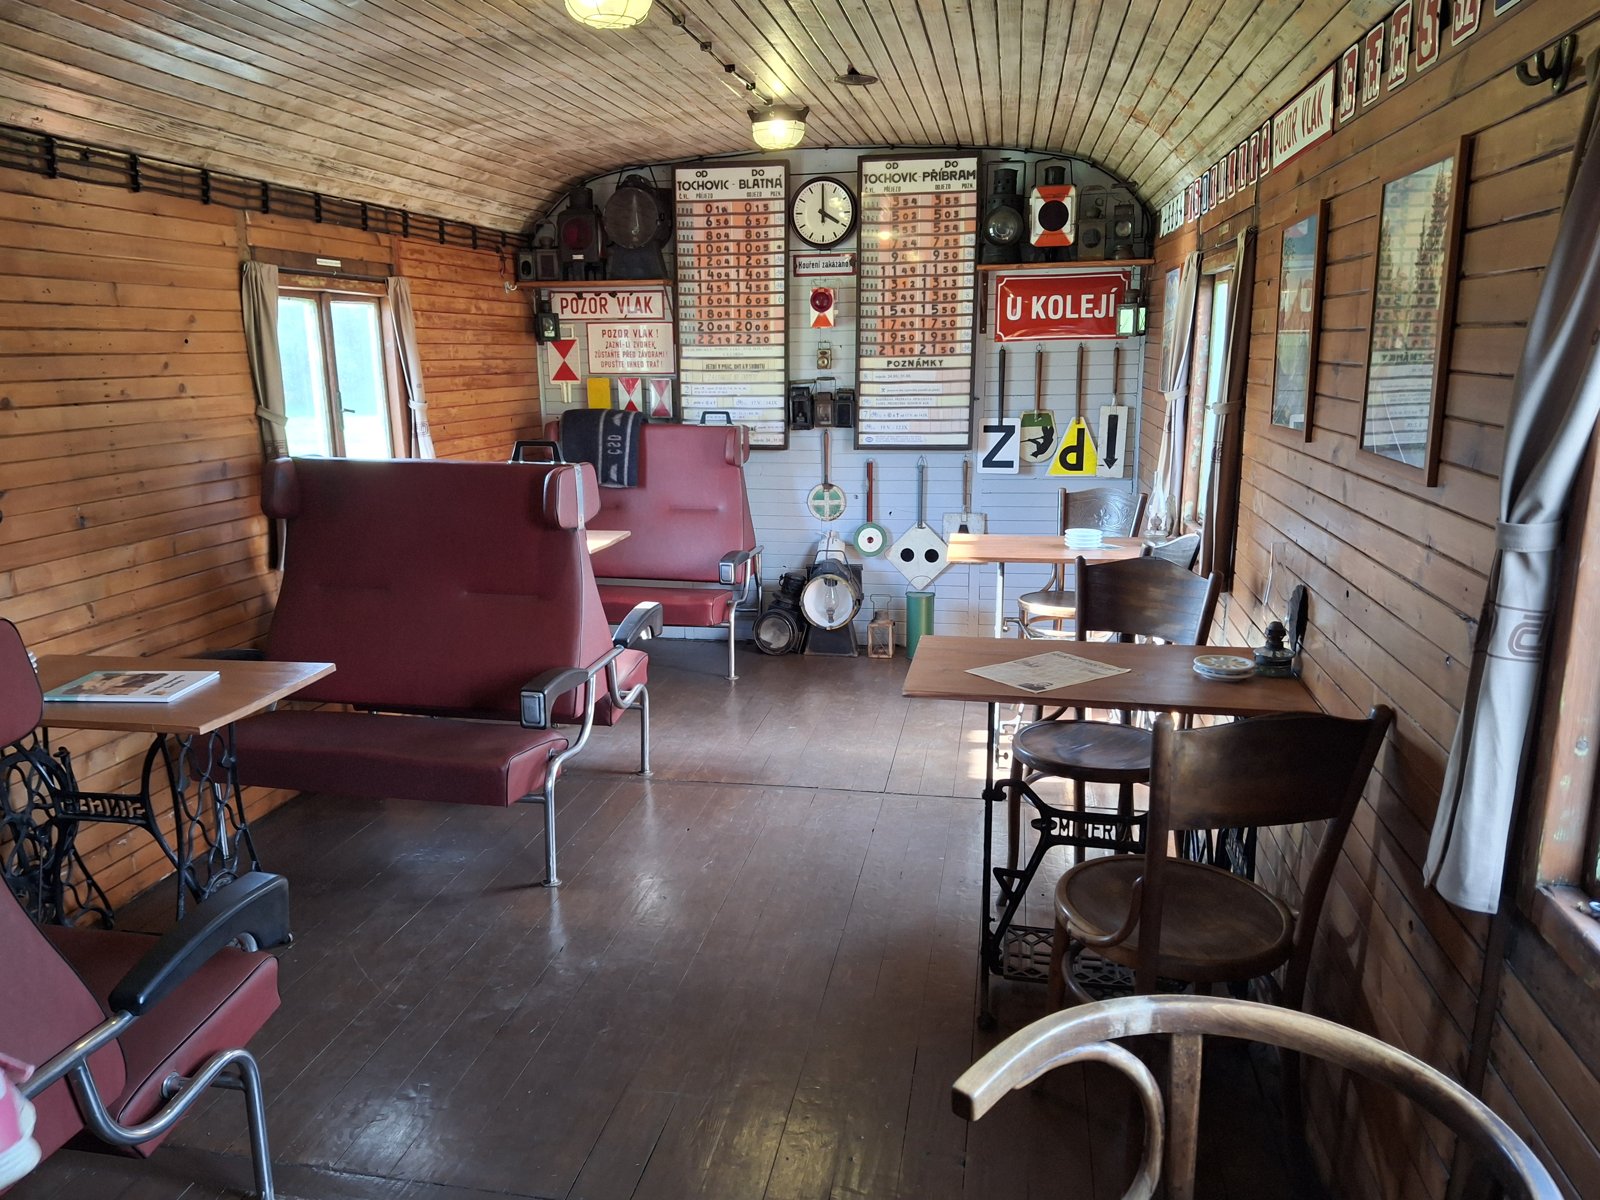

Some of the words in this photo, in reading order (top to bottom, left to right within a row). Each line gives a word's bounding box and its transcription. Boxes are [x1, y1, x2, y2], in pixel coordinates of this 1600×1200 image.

[1275, 106, 1298, 157] POZOR
[1302, 84, 1325, 137] VLAK
[885, 162, 899, 170] OD
[944, 160, 959, 168] DO
[695, 170, 709, 178] OD
[751, 168, 765, 177] DO
[677, 180, 730, 191] TOCHOVIC
[738, 174, 783, 190] BLATNÁ
[798, 260, 821, 270] Kouření
[560, 297, 608, 315] POZOR
[617, 296, 653, 314] VLAK
[1005, 295, 1022, 321] U
[1031, 287, 1118, 320] KOLEJÍ
[601, 329, 629, 338] POZOR
[623, 350, 637, 358] PŘED
[886, 357, 944, 368] POZNÁMKY
[983, 425, 1015, 468] Z
